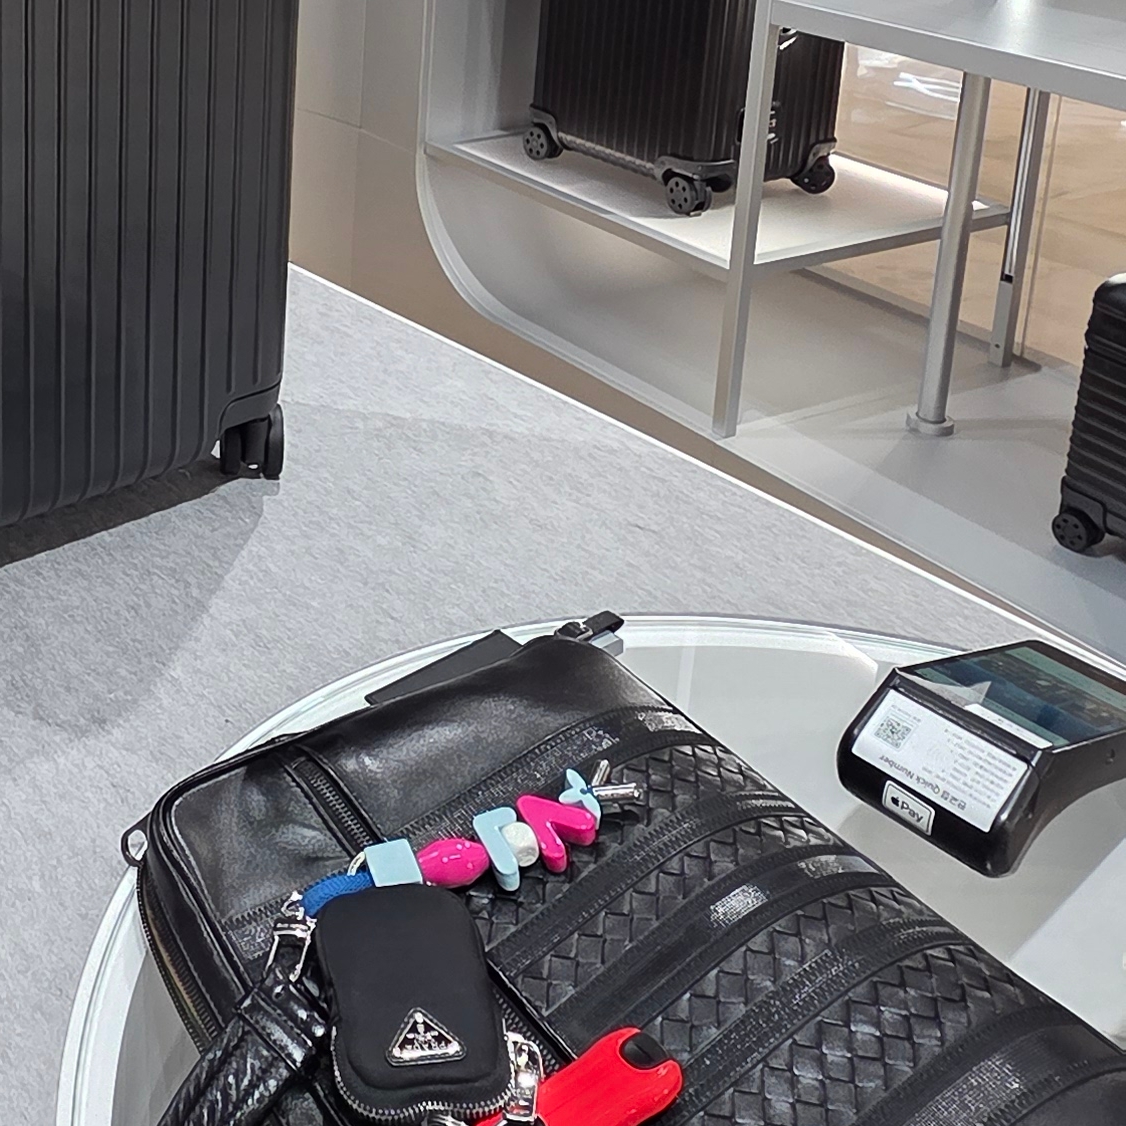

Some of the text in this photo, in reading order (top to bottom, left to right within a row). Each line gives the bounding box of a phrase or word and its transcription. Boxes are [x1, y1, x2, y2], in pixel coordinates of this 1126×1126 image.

[879, 755, 914, 779] Number
[916, 775, 940, 794] Quick
[901, 801, 923, 822] Pay
